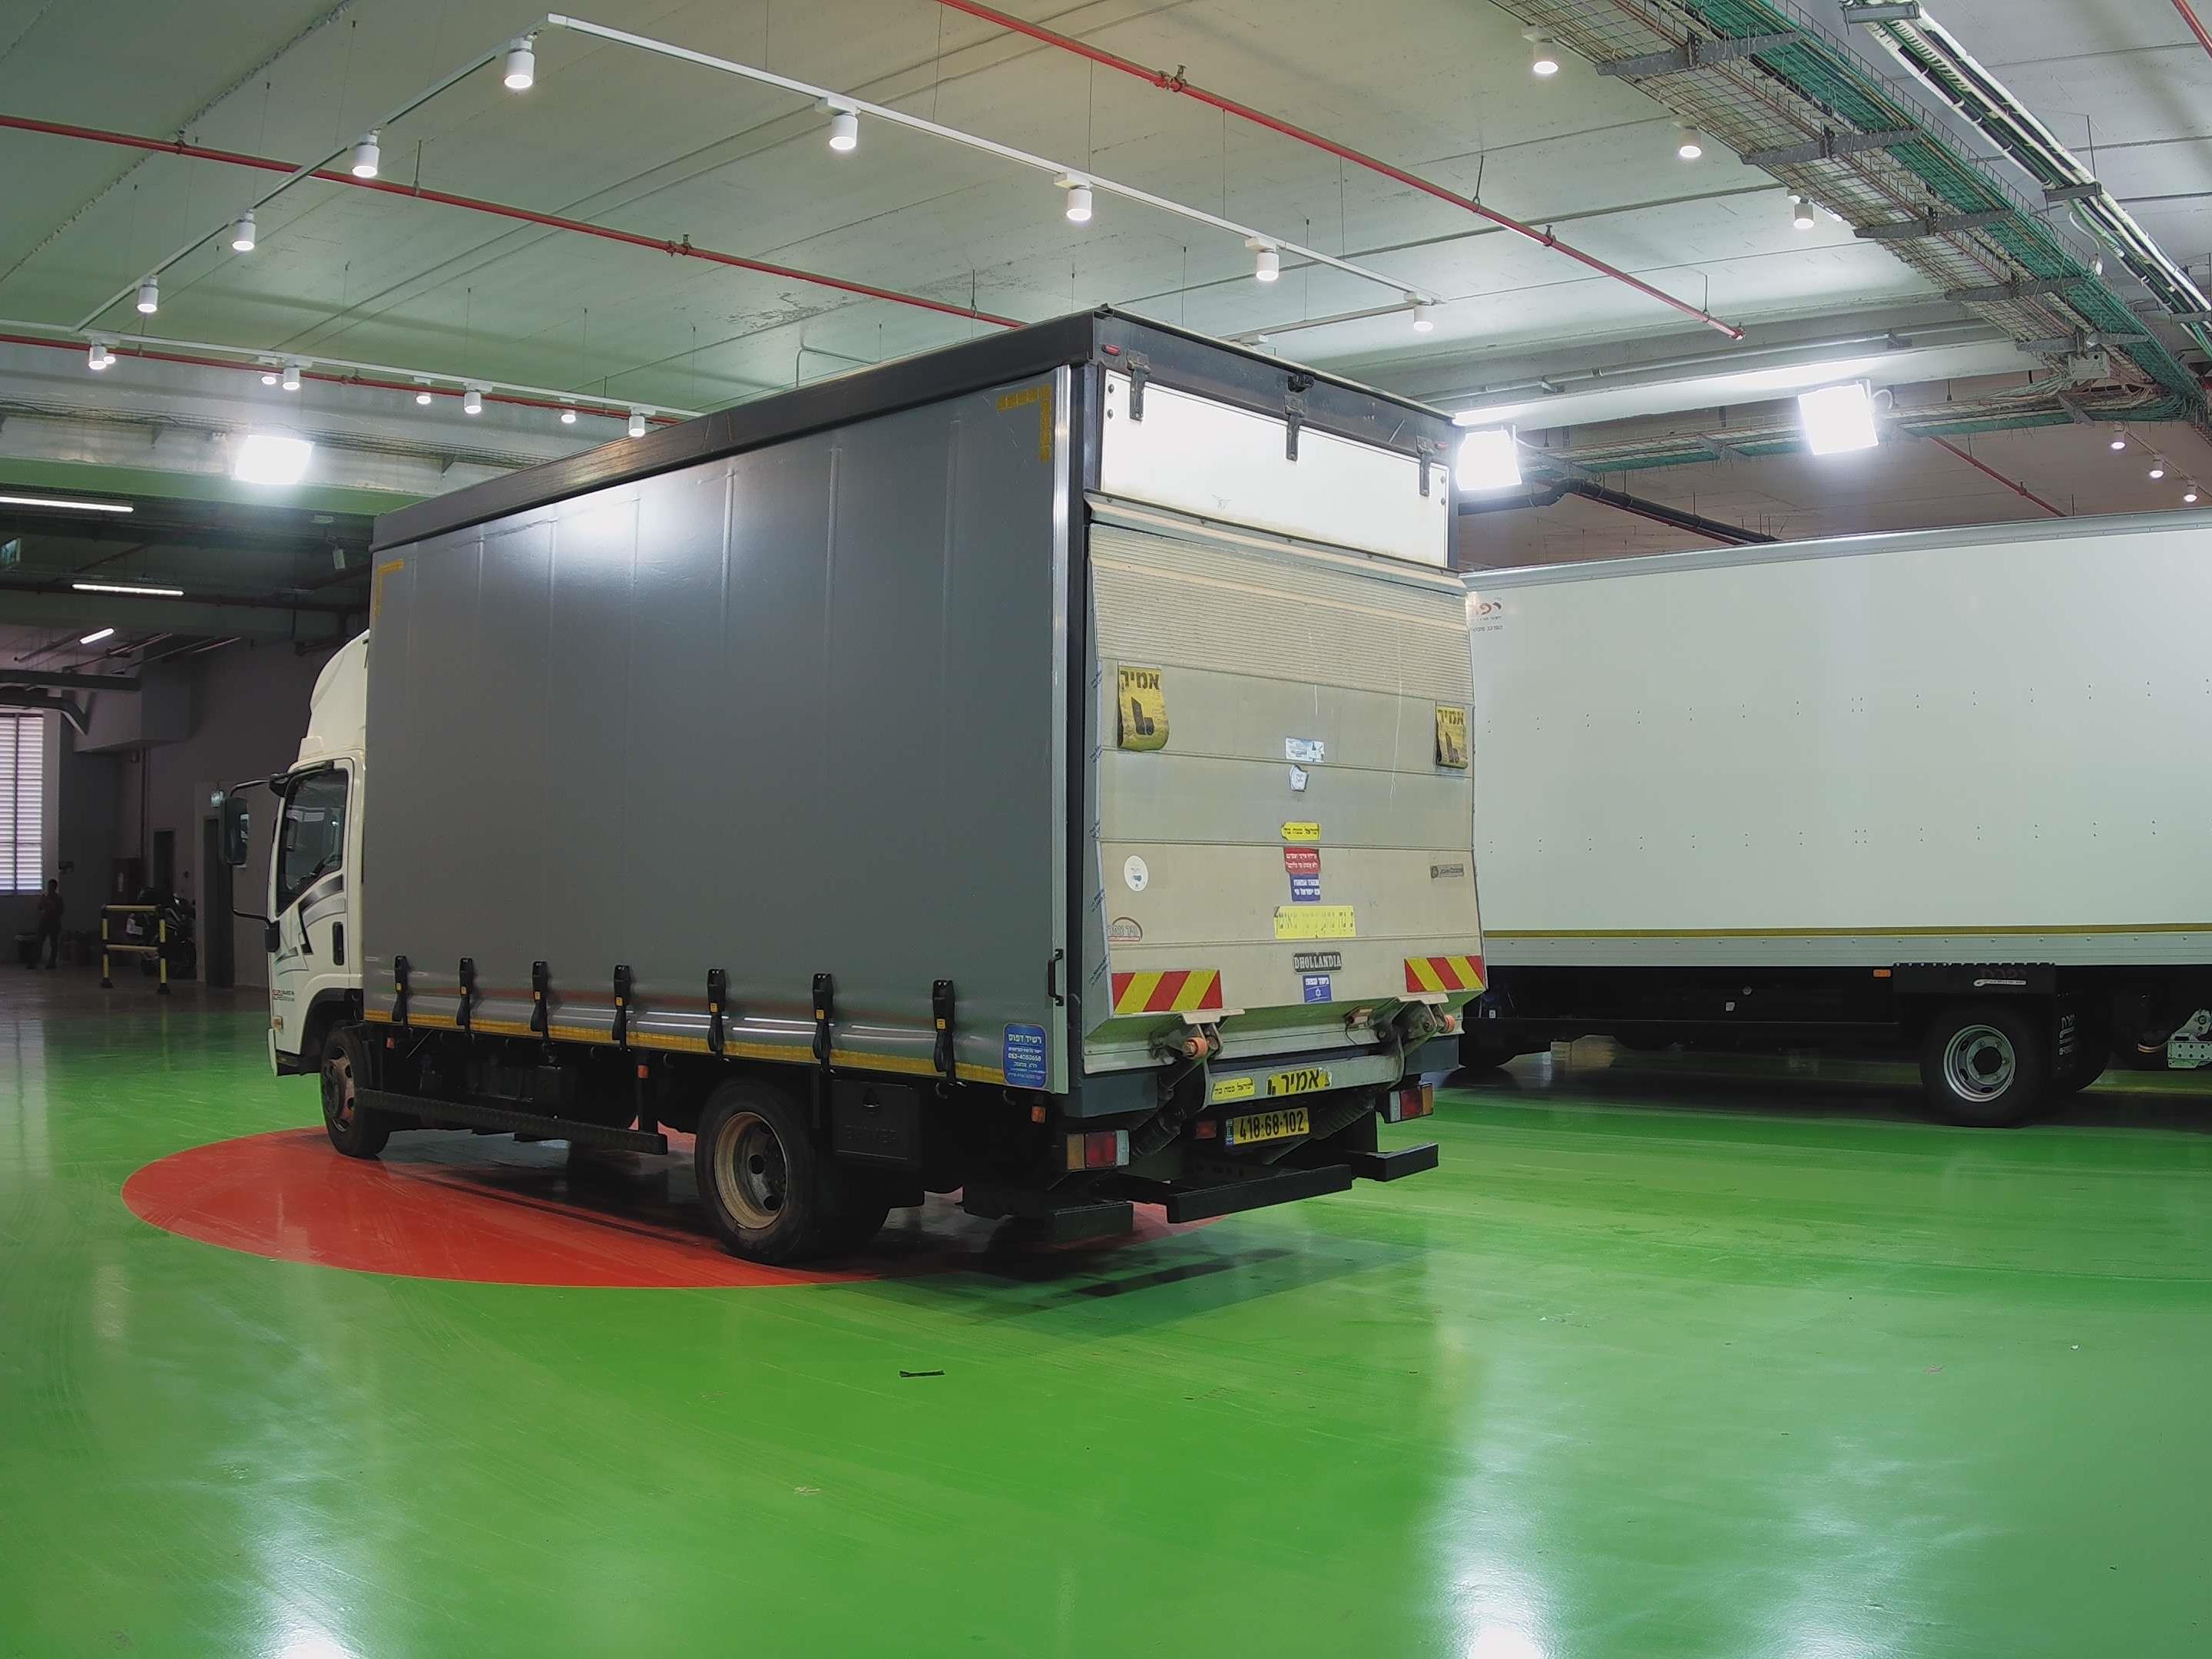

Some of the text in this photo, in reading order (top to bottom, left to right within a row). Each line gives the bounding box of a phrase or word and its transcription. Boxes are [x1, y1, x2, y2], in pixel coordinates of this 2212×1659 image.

[1120, 671, 1160, 690] אמיר
[1437, 709, 1464, 726] אמיר
[1294, 955, 1342, 969] DHOLLANDIA
[1281, 1068, 1320, 1094] אמיר
